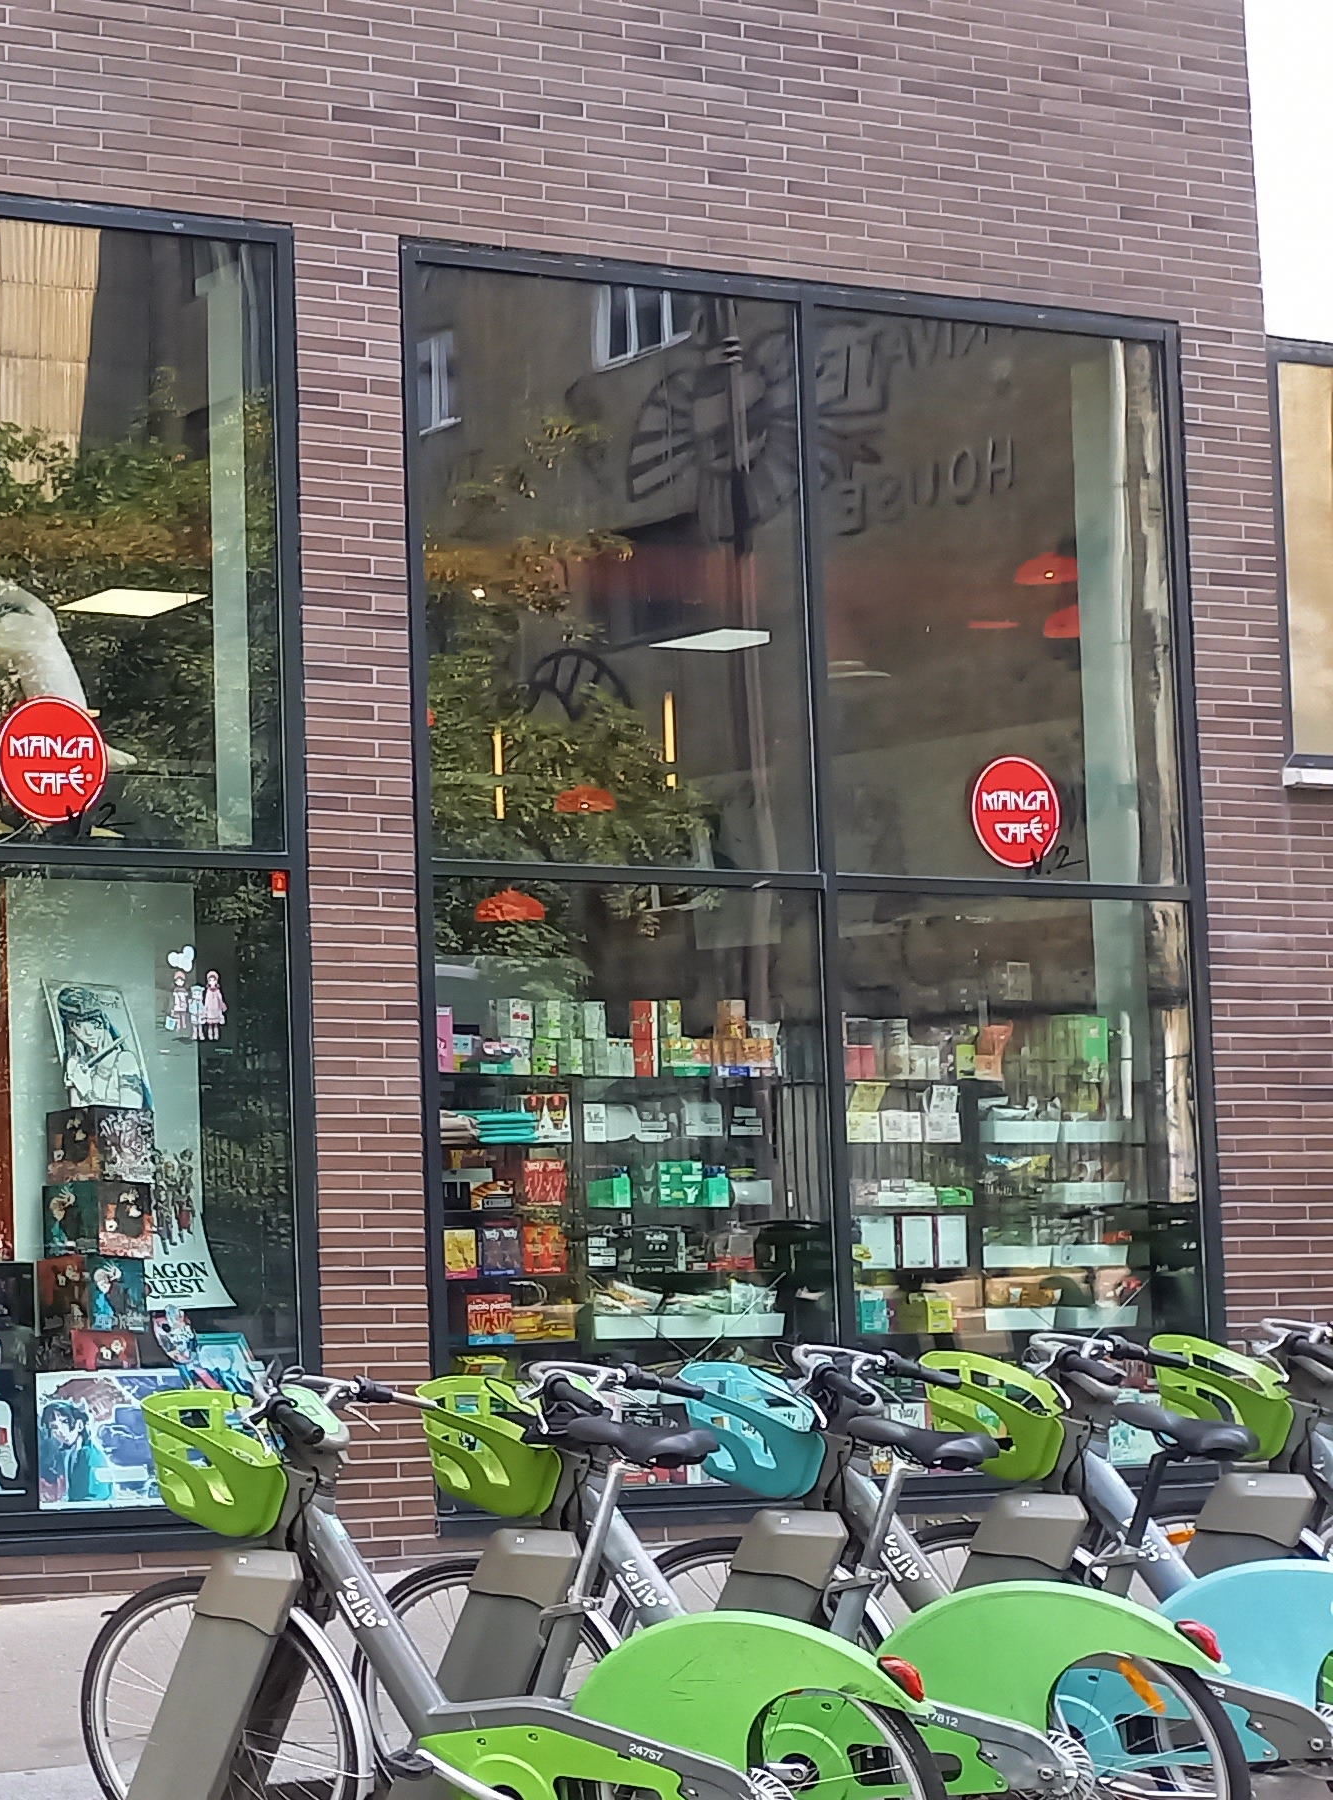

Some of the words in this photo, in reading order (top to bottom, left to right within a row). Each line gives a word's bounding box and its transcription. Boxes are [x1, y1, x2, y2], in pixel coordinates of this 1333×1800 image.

[9, 735, 94, 759] MANGA
[24, 765, 85, 795] CAFÉ
[982, 790, 1051, 811] MANGA
[994, 815, 1044, 844] CAFÉ
[144, 1261, 209, 1279] AGON
[628, 1743, 664, 1761] 24757
